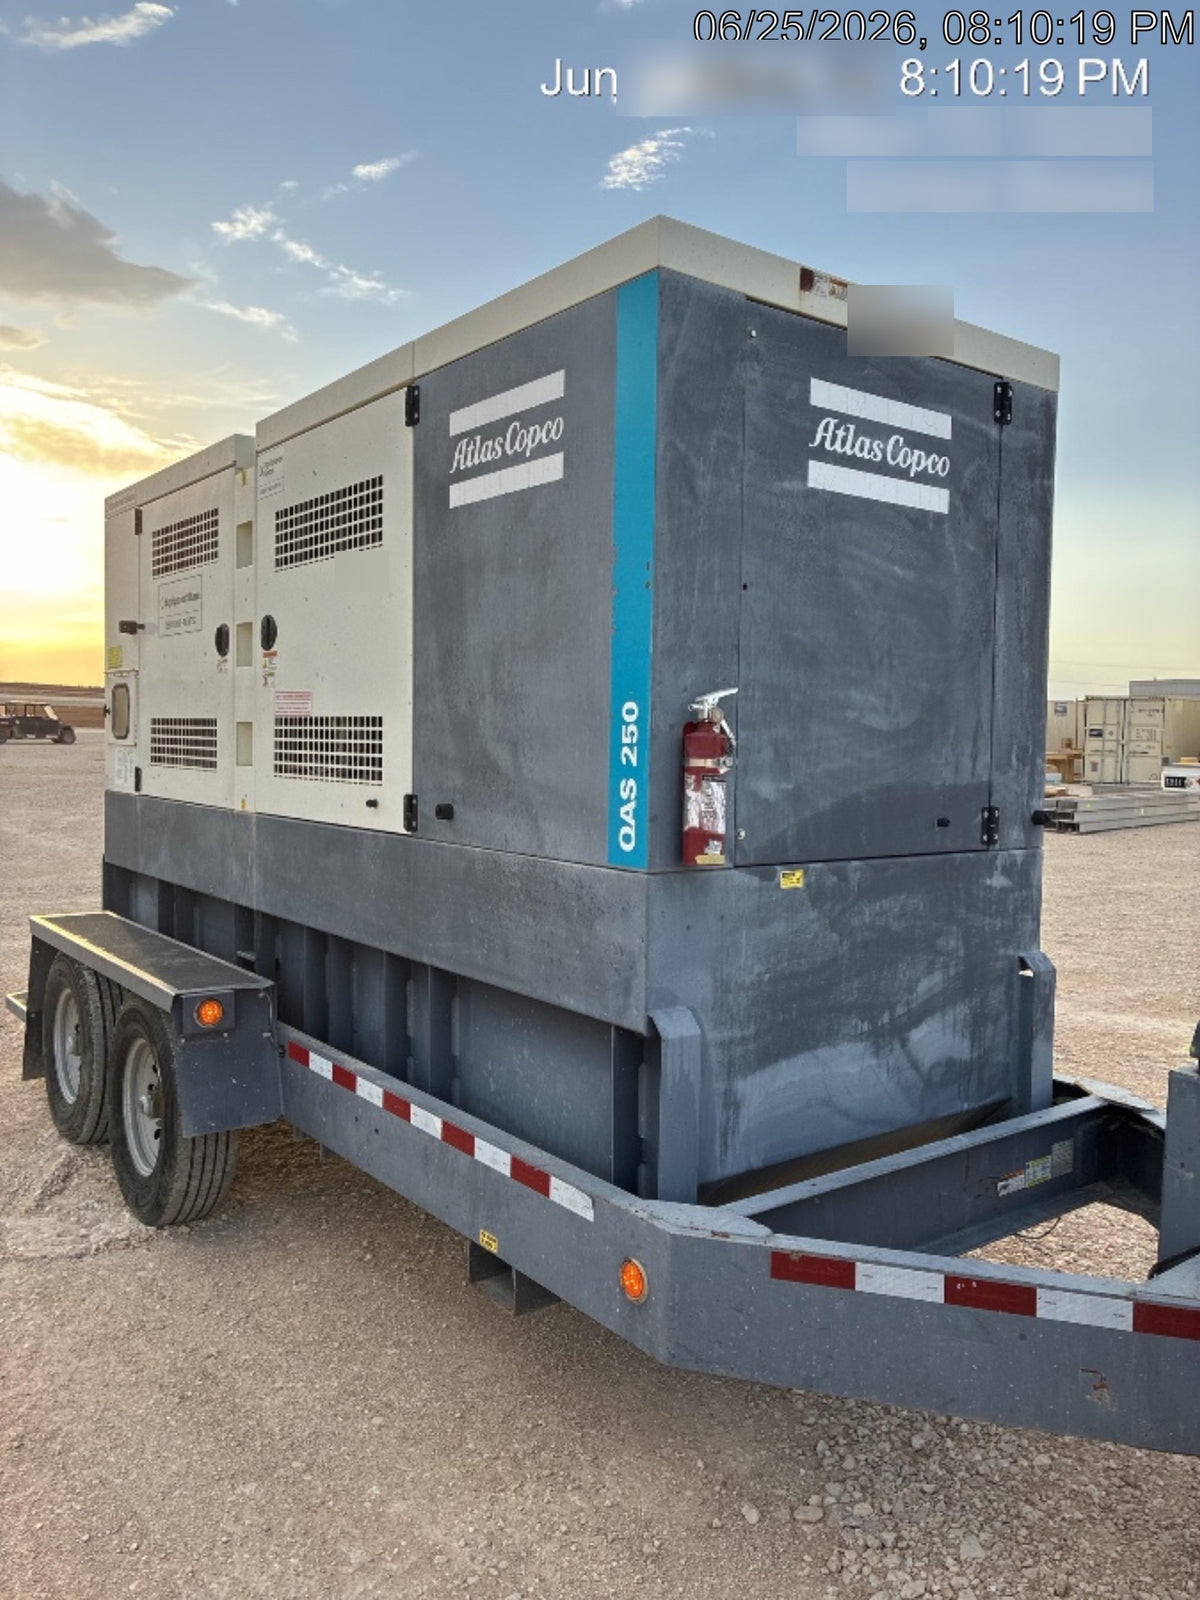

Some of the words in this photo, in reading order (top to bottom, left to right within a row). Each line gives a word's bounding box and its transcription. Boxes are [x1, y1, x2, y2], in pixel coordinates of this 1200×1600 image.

[448, 434, 504, 474] Atlas
[504, 416, 565, 458] Copco
[808, 416, 884, 462] Atlas
[885, 434, 951, 478] Copco
[621, 701, 639, 767] 250
[618, 778, 637, 852] QAS
